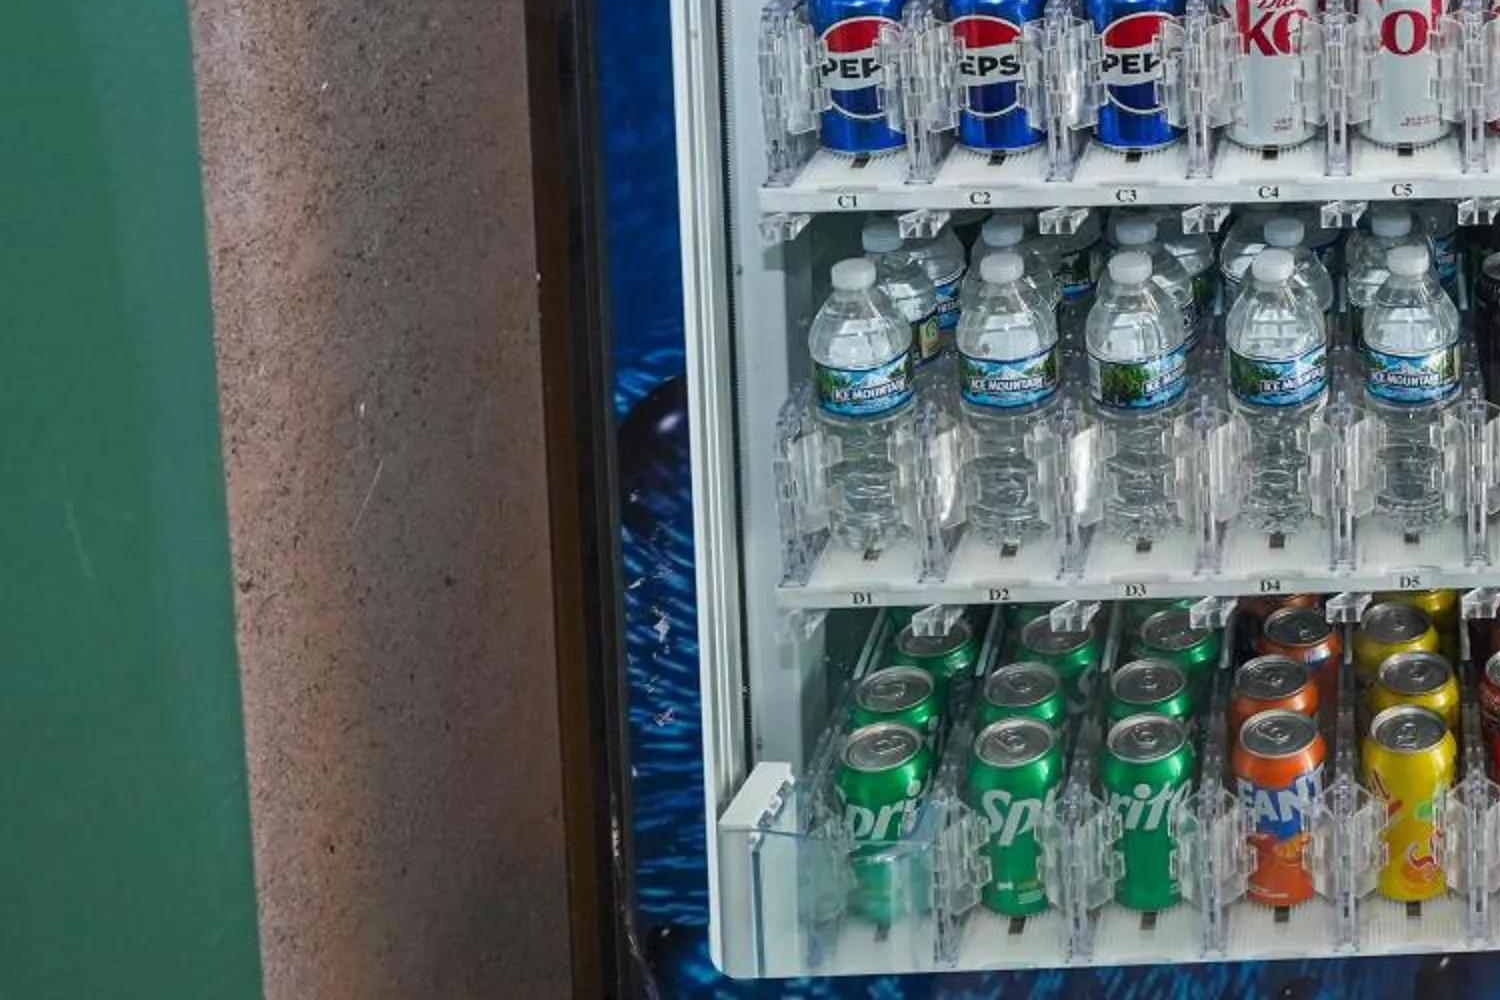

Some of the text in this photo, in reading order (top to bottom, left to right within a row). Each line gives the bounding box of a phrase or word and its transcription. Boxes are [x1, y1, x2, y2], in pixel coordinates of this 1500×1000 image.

[1115, 189, 1137, 203] C3
[1257, 186, 1280, 199] C4
[1391, 183, 1413, 197] C5
[837, 195, 857, 208] C1
[969, 191, 991, 205] C2
[1260, 579, 1281, 593] D4
[1399, 575, 1421, 589] D5
[989, 587, 1009, 601] D2
[1125, 583, 1147, 597] D3
[850, 591, 873, 605] D1
